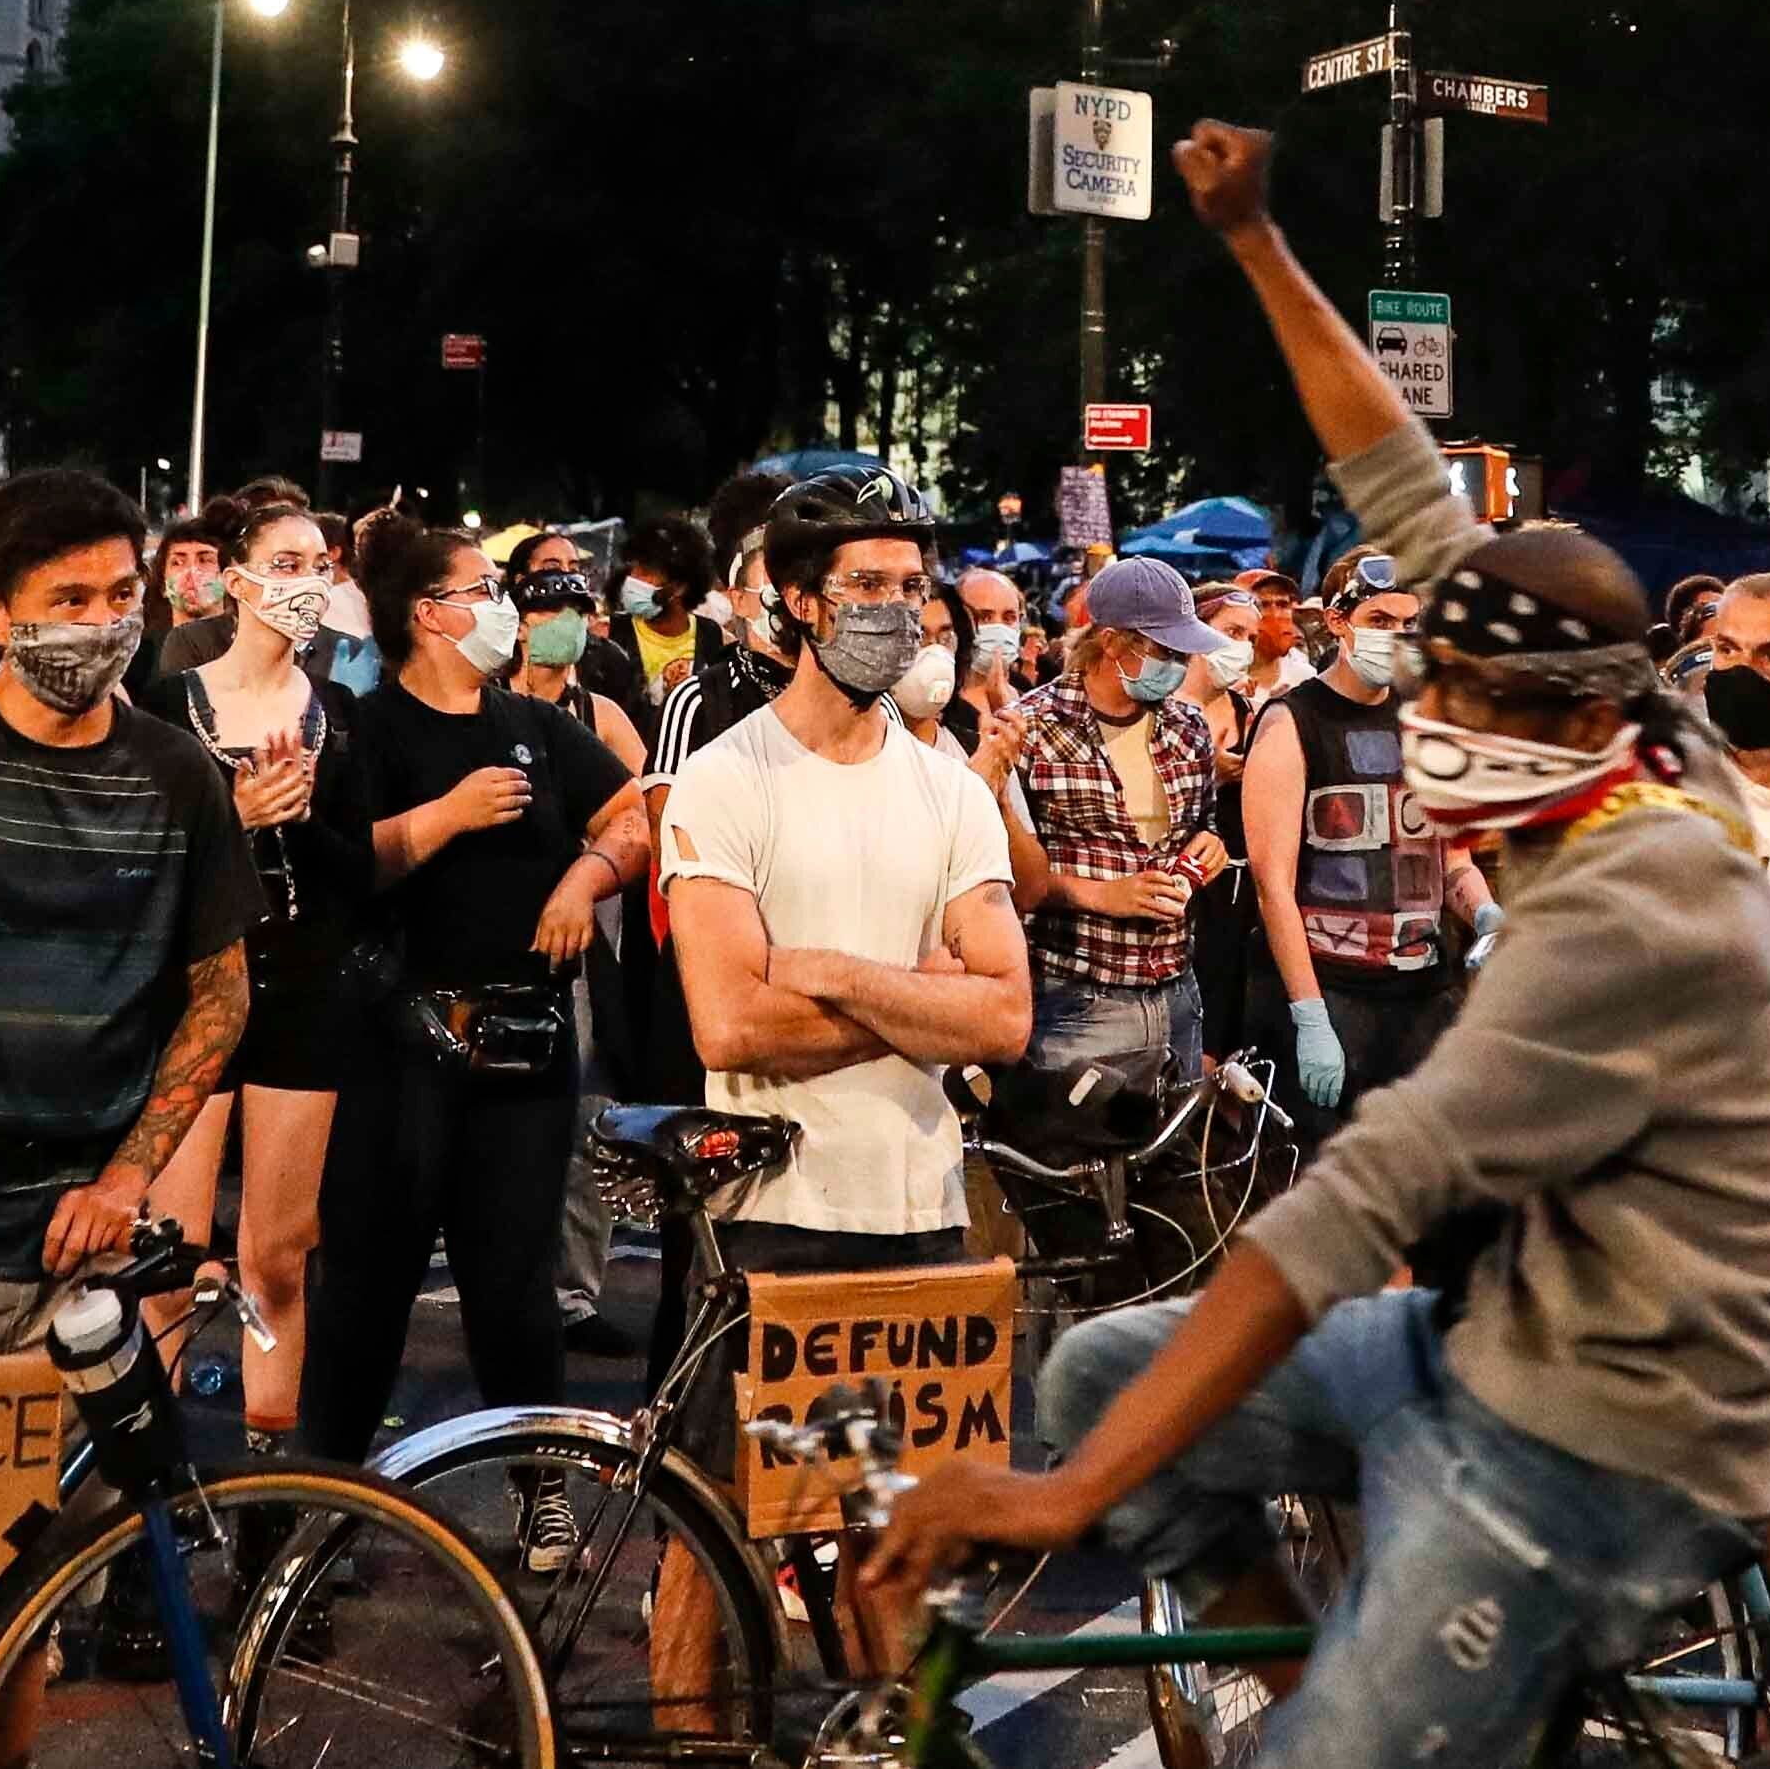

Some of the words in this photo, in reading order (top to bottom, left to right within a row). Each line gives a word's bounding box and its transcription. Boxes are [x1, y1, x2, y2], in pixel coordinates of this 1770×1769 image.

[1307, 51, 1362, 89] CENTRE
[1366, 43, 1387, 72] ST
[1075, 94, 1132, 122] NYPD
[1433, 78, 1529, 111] CHAMBERS
[1067, 168, 1137, 198] CAMERA
[1376, 299, 1401, 316] BIKE
[1406, 301, 1444, 318] ROUTE
[1380, 361, 1444, 382] SHARED
[1402, 386, 1432, 406] ANE
[762, 1315, 998, 1383] DEFUND
